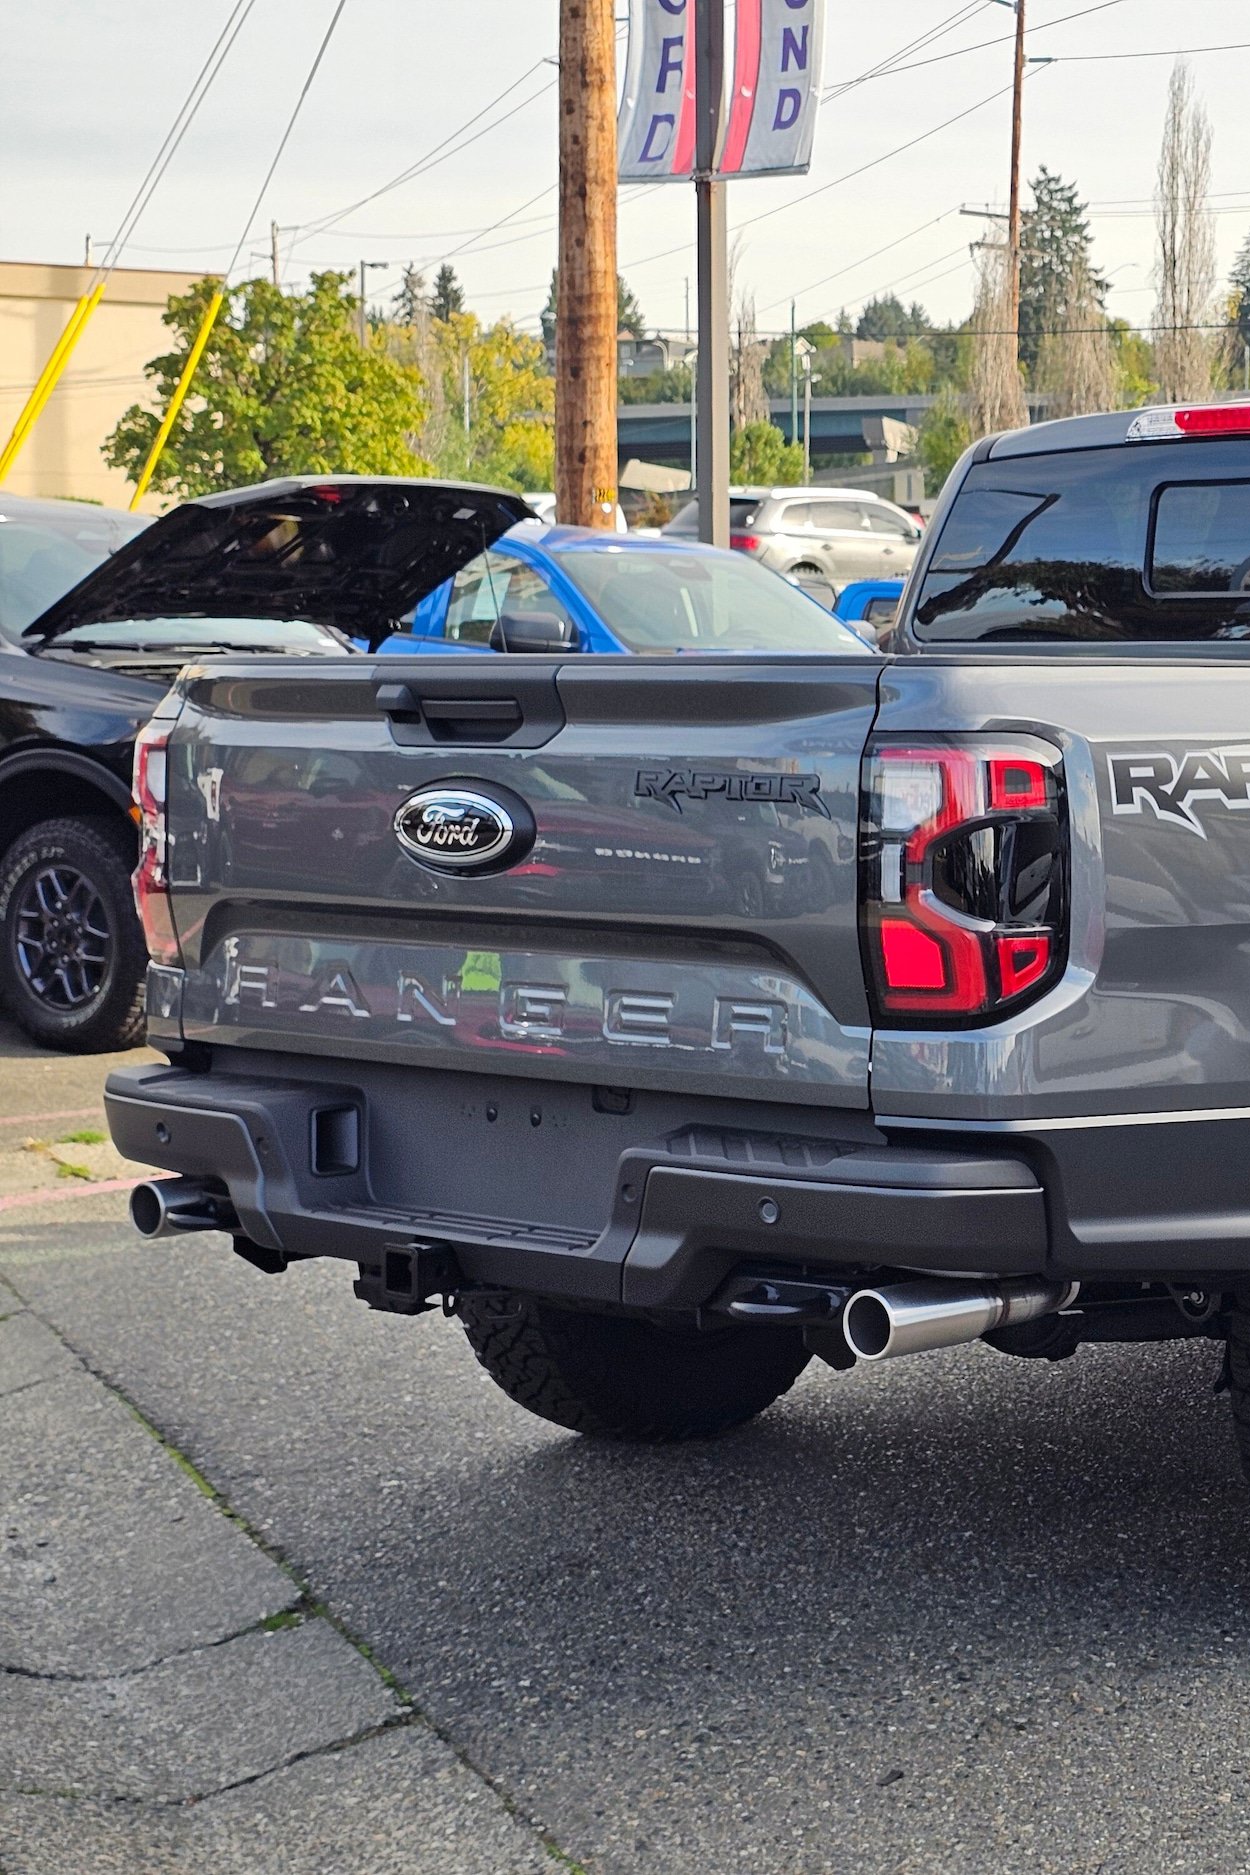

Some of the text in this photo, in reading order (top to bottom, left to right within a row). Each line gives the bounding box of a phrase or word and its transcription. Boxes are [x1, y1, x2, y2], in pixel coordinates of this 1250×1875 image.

[634, 768, 831, 820] RAPTOR
[416, 804, 480, 847] Ford
[225, 958, 789, 1054] RANGER
